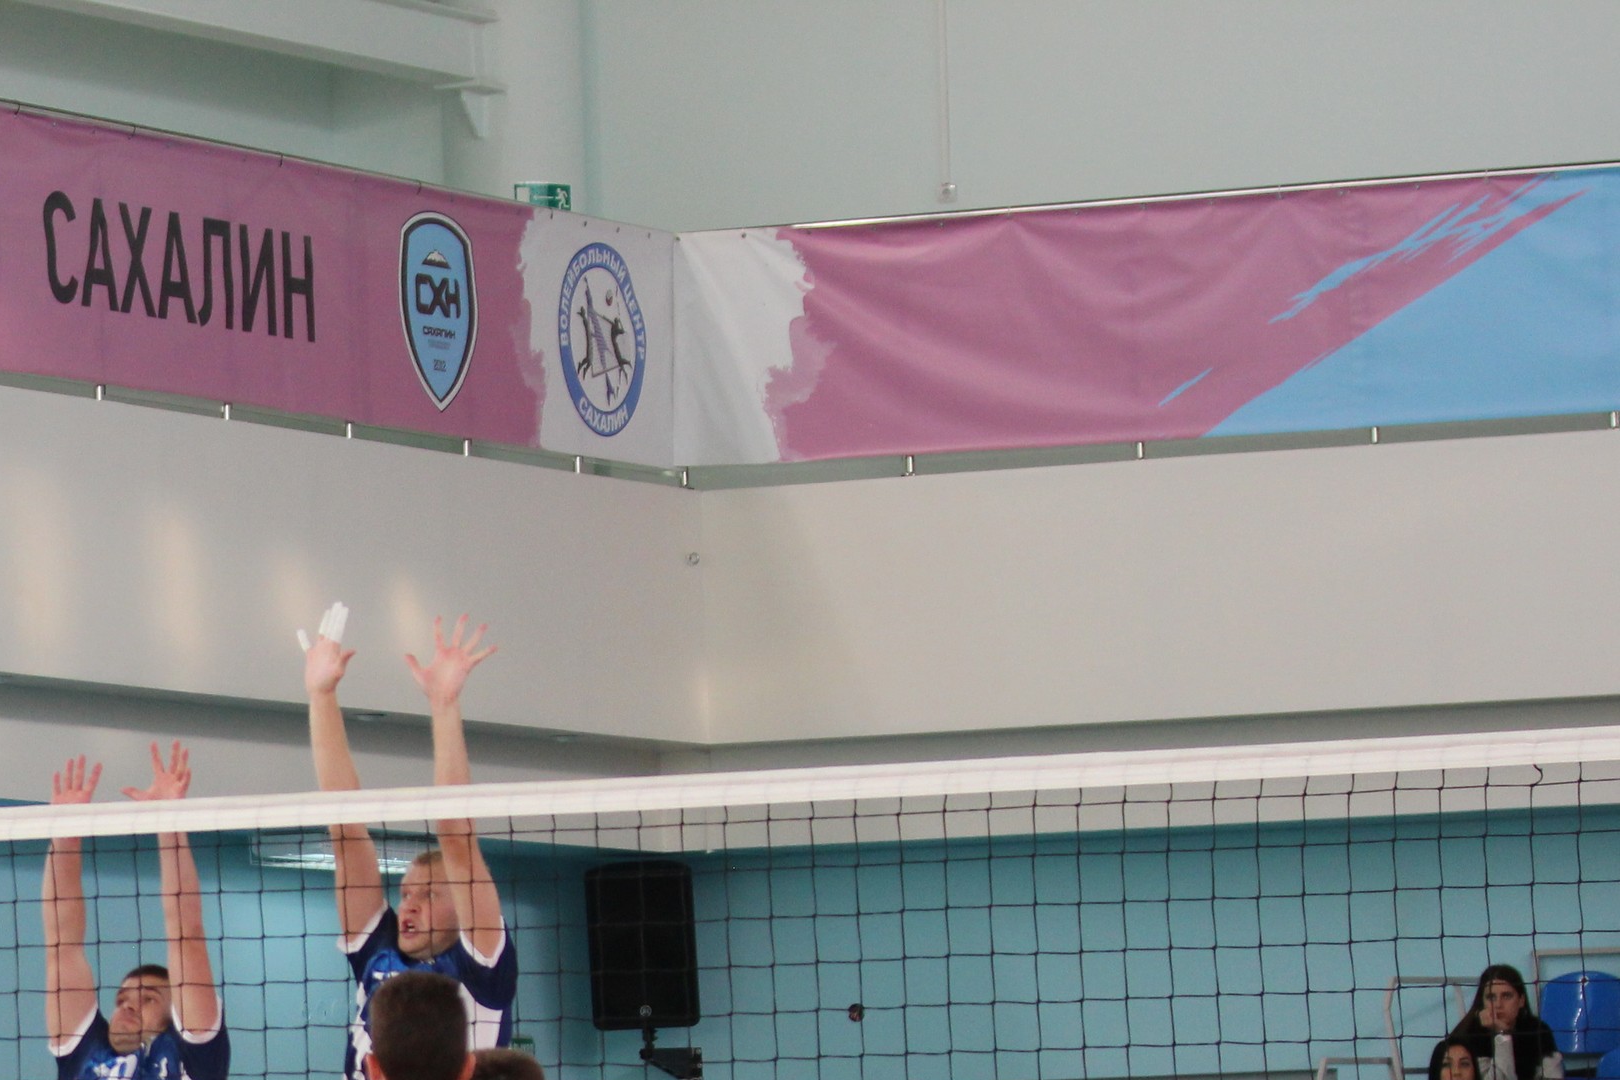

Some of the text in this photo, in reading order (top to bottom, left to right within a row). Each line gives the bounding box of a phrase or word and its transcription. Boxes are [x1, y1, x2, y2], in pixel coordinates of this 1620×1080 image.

[43, 190, 316, 343] САХАЛИН
[559, 247, 645, 360] ВОЛЕЙБОЛЬНЫЙ ЦЕНТР
[578, 396, 629, 434] САХАЛИН
